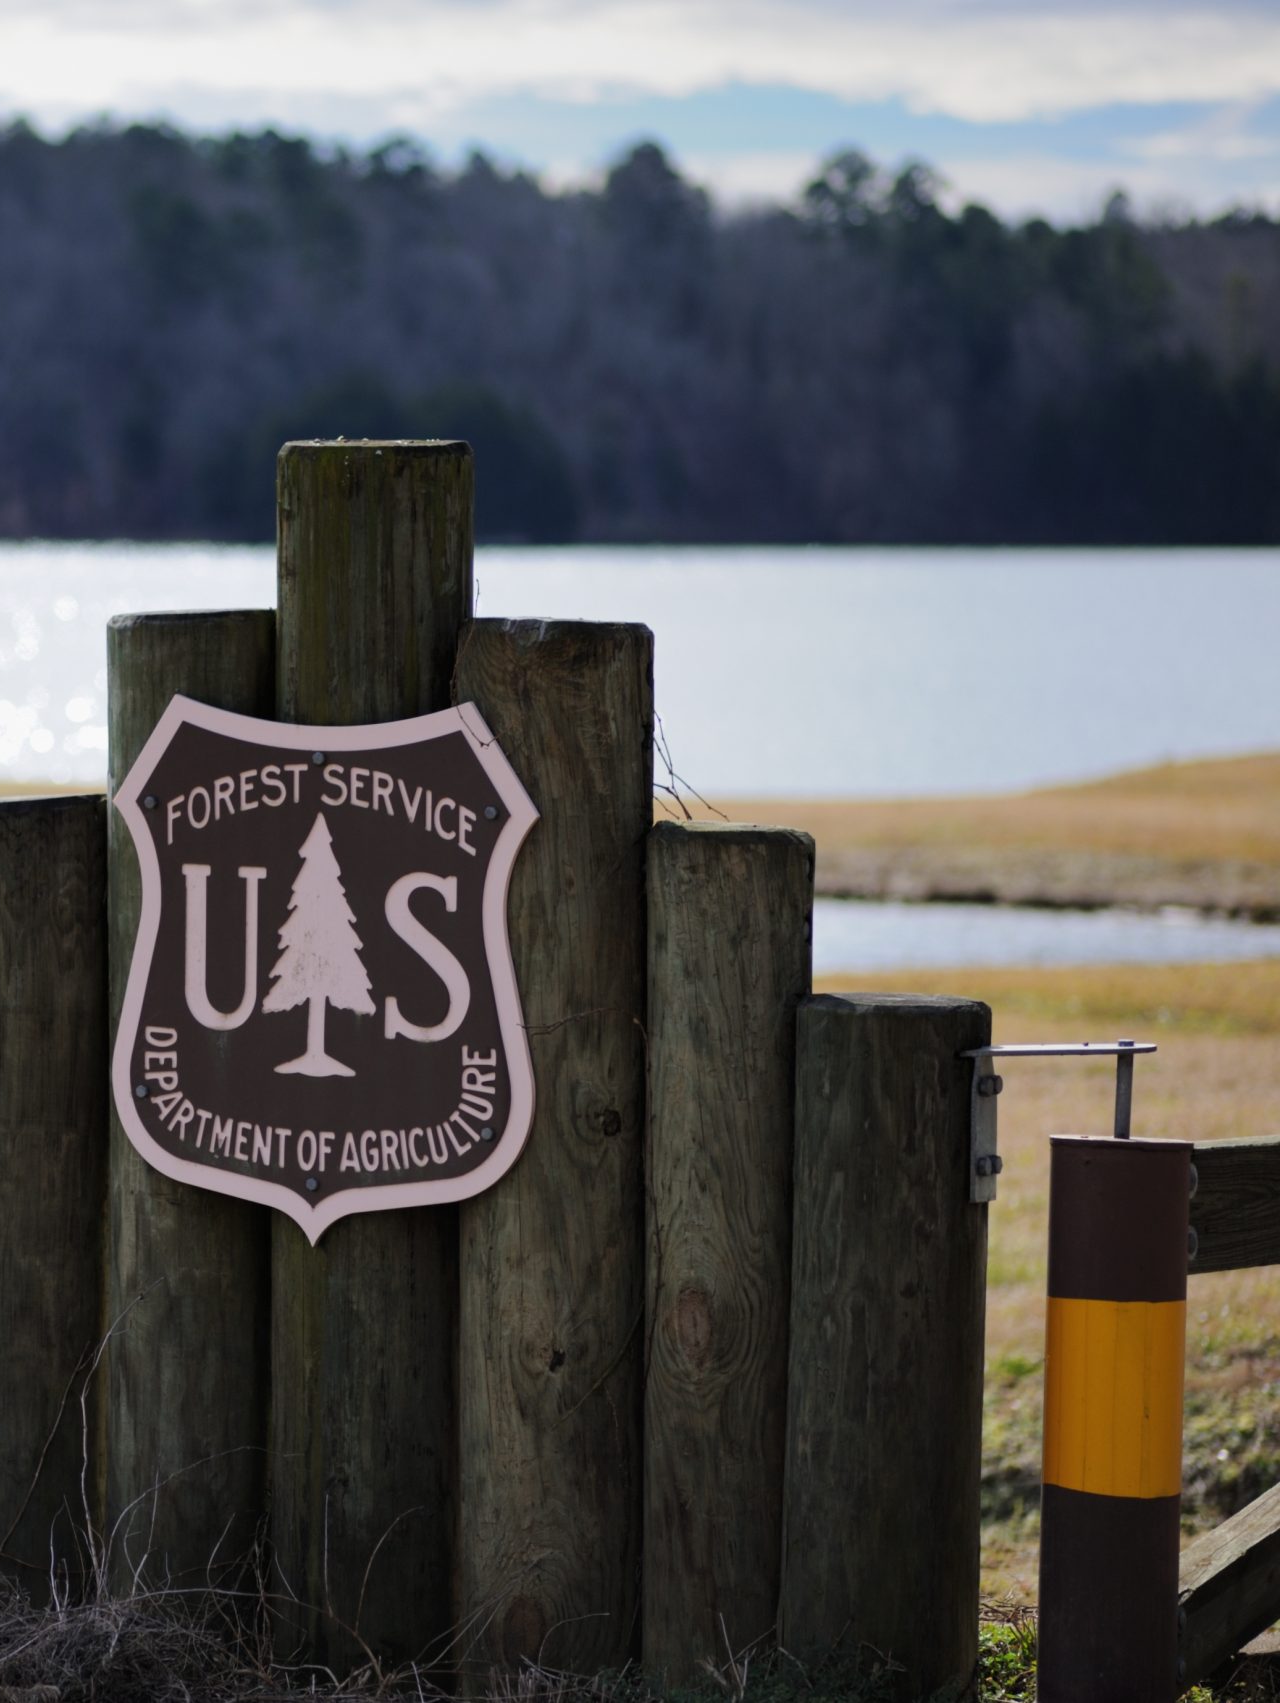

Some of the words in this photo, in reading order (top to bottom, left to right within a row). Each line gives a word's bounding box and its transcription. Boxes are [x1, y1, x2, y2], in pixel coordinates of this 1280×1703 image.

[168, 765, 308, 844] FOREST
[321, 765, 477, 855] SERVICE
[144, 1026, 292, 1168] DEPARTMENT
[297, 1130, 336, 1172] OF
[340, 1045, 497, 1173] AGRICULTURE
